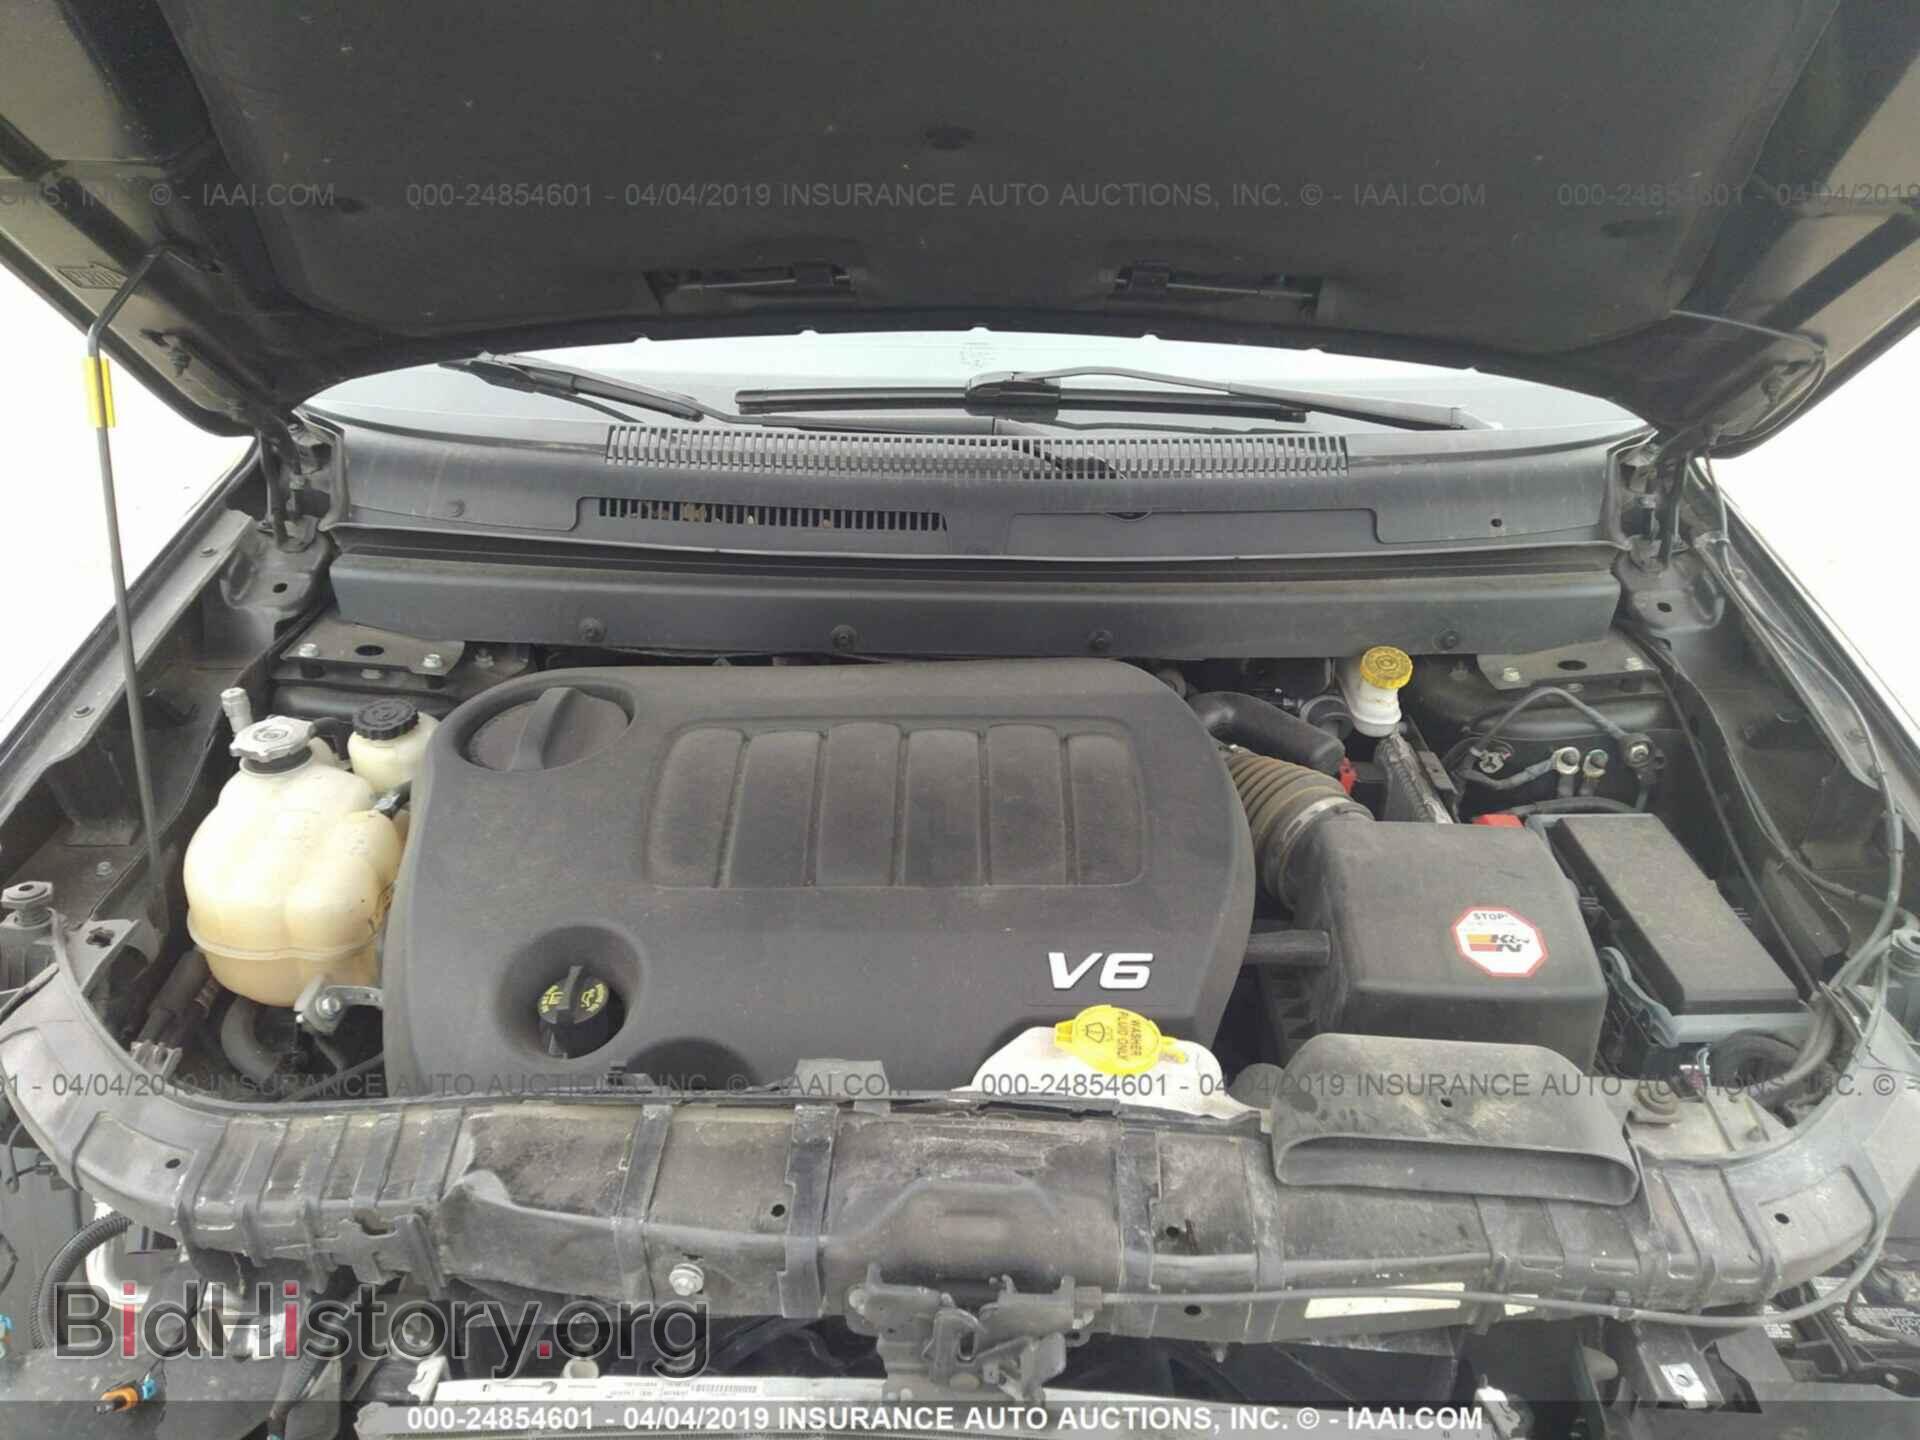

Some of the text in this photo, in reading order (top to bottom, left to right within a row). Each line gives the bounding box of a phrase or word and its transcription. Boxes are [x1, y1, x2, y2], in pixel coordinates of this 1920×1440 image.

[1473, 912, 1505, 921] STOP
[1048, 952, 1154, 989] V6
[1130, 1019, 1142, 1057] WASHER
